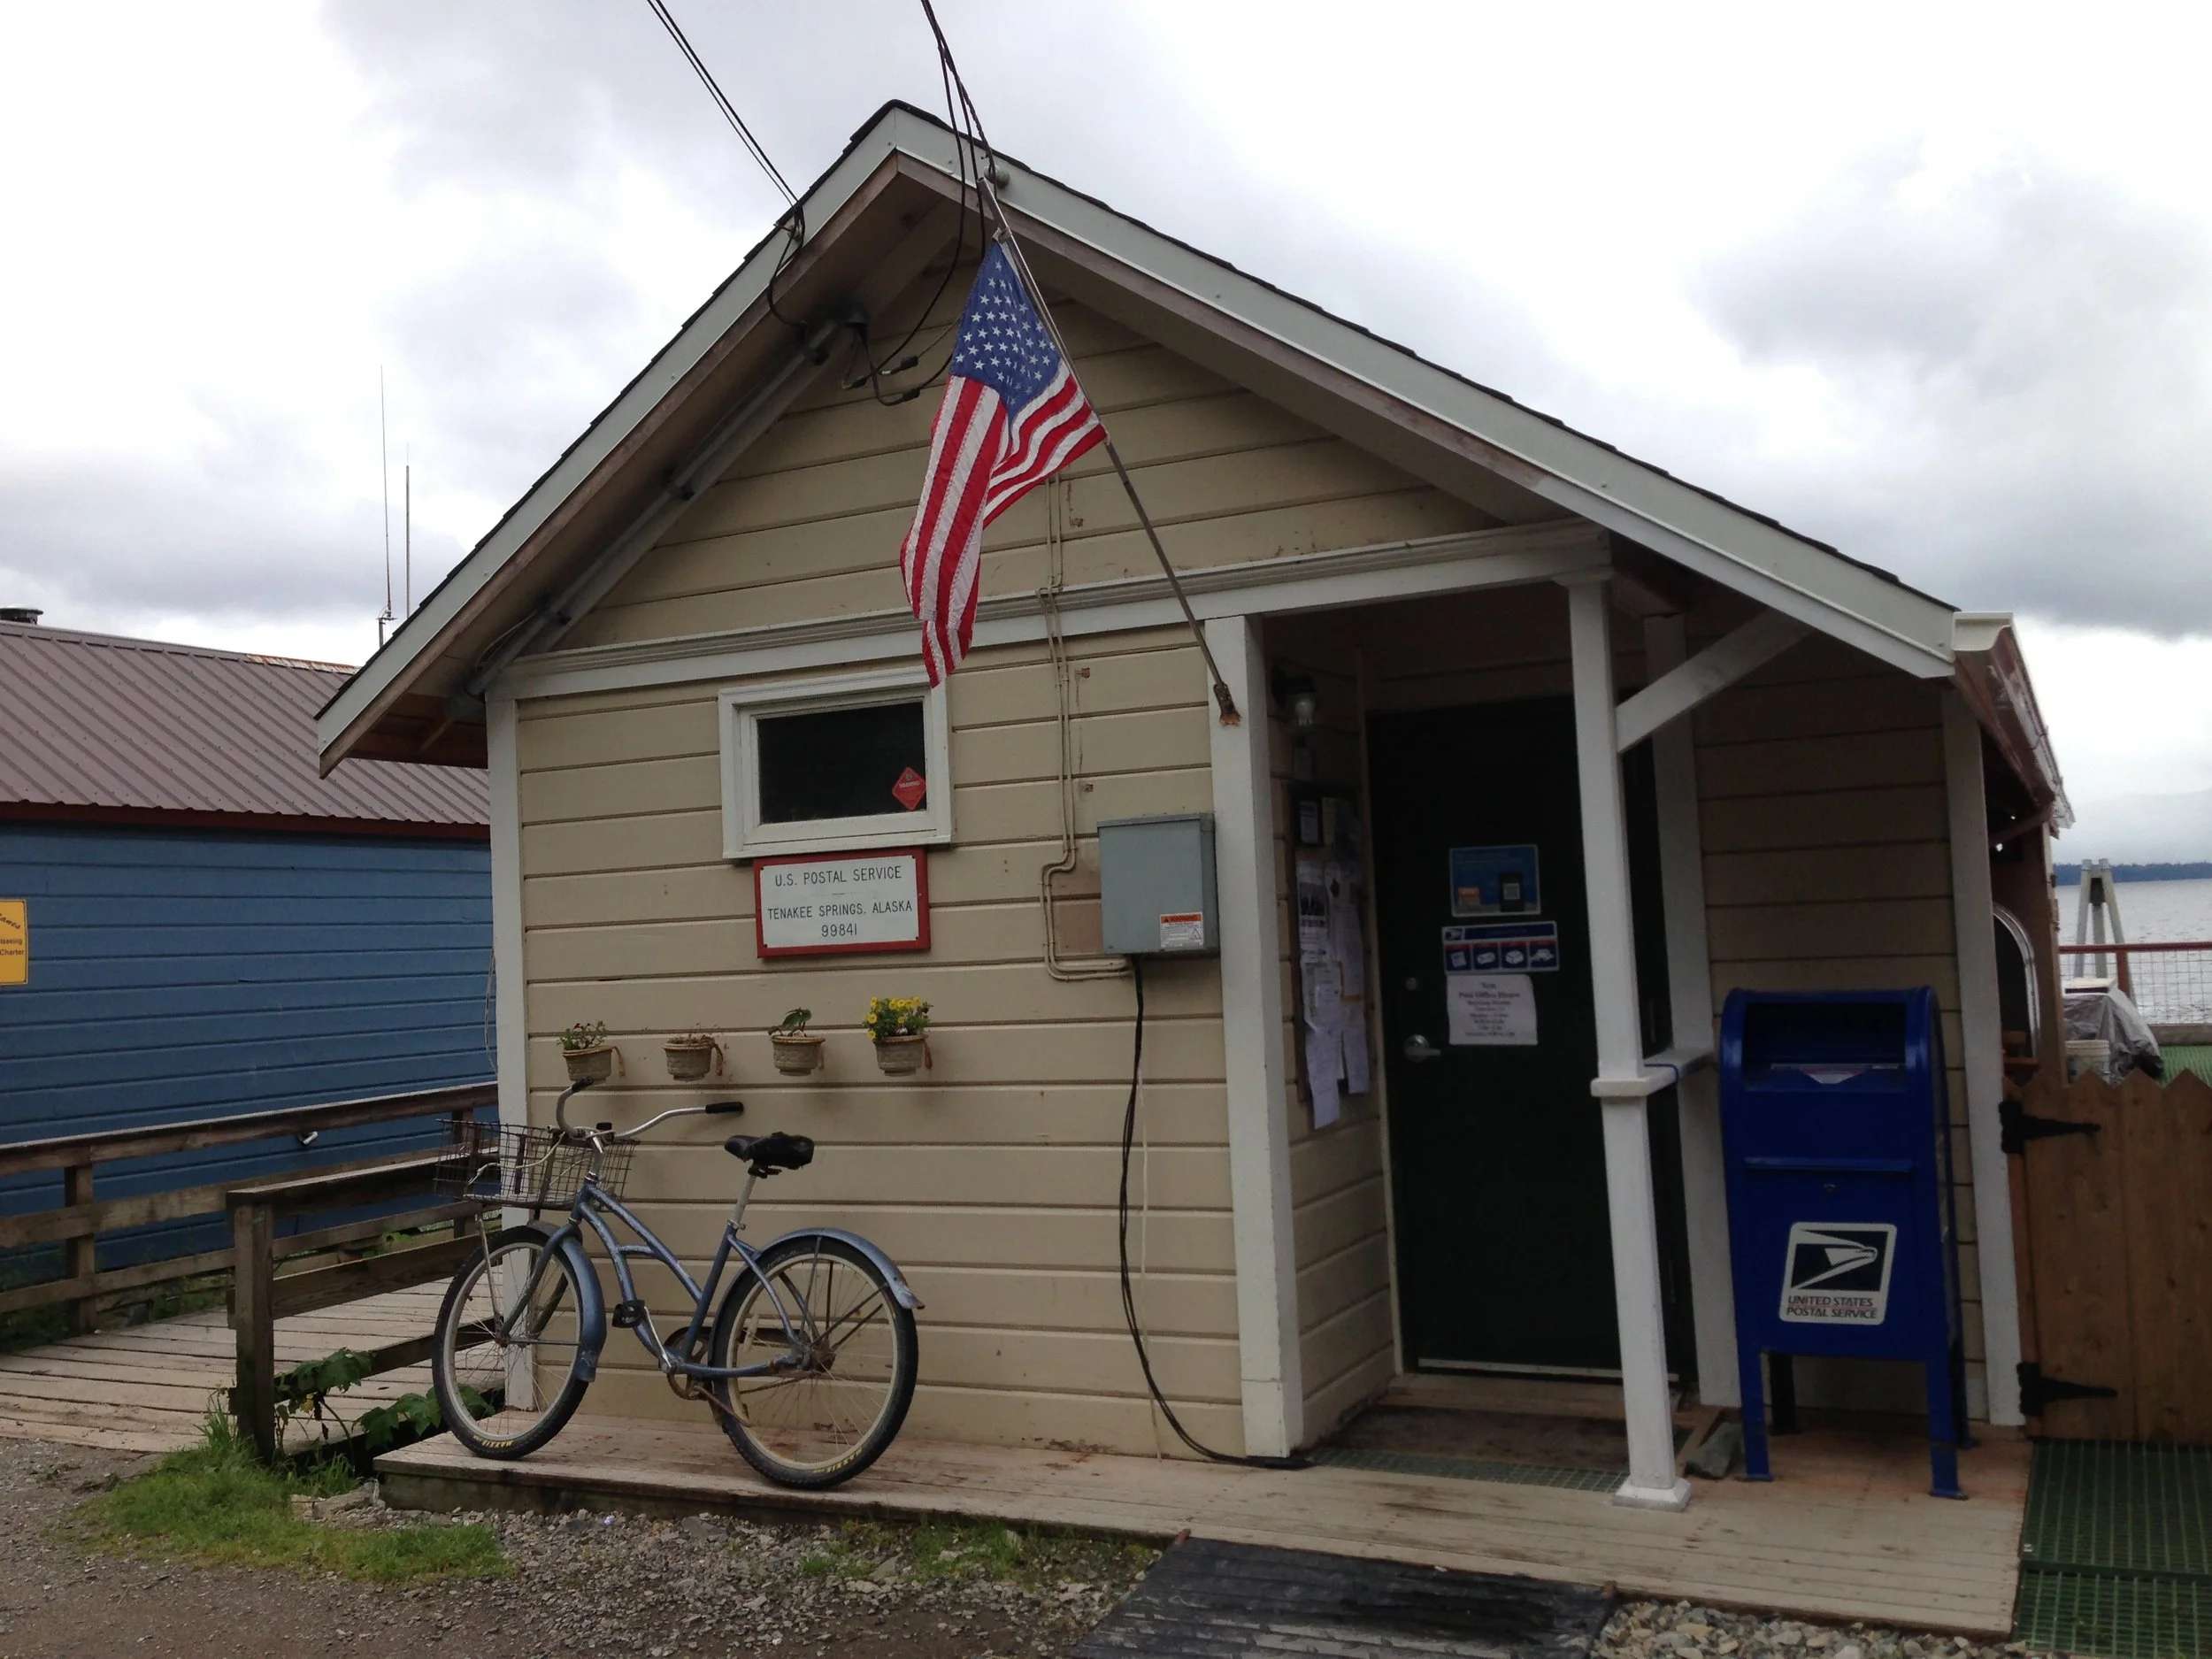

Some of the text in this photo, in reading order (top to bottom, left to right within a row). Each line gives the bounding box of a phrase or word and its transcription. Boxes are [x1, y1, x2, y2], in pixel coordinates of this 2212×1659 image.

[775, 865, 902, 887] U.S. POSTAL SERVICE
[767, 906, 812, 920] TENAKEE
[872, 900, 912, 914] ALASKA
[821, 923, 857, 937] 99841
[1787, 1295, 1873, 1307] UNITED STATES
[1786, 1307, 1878, 1319] POSTAL SERVICE
